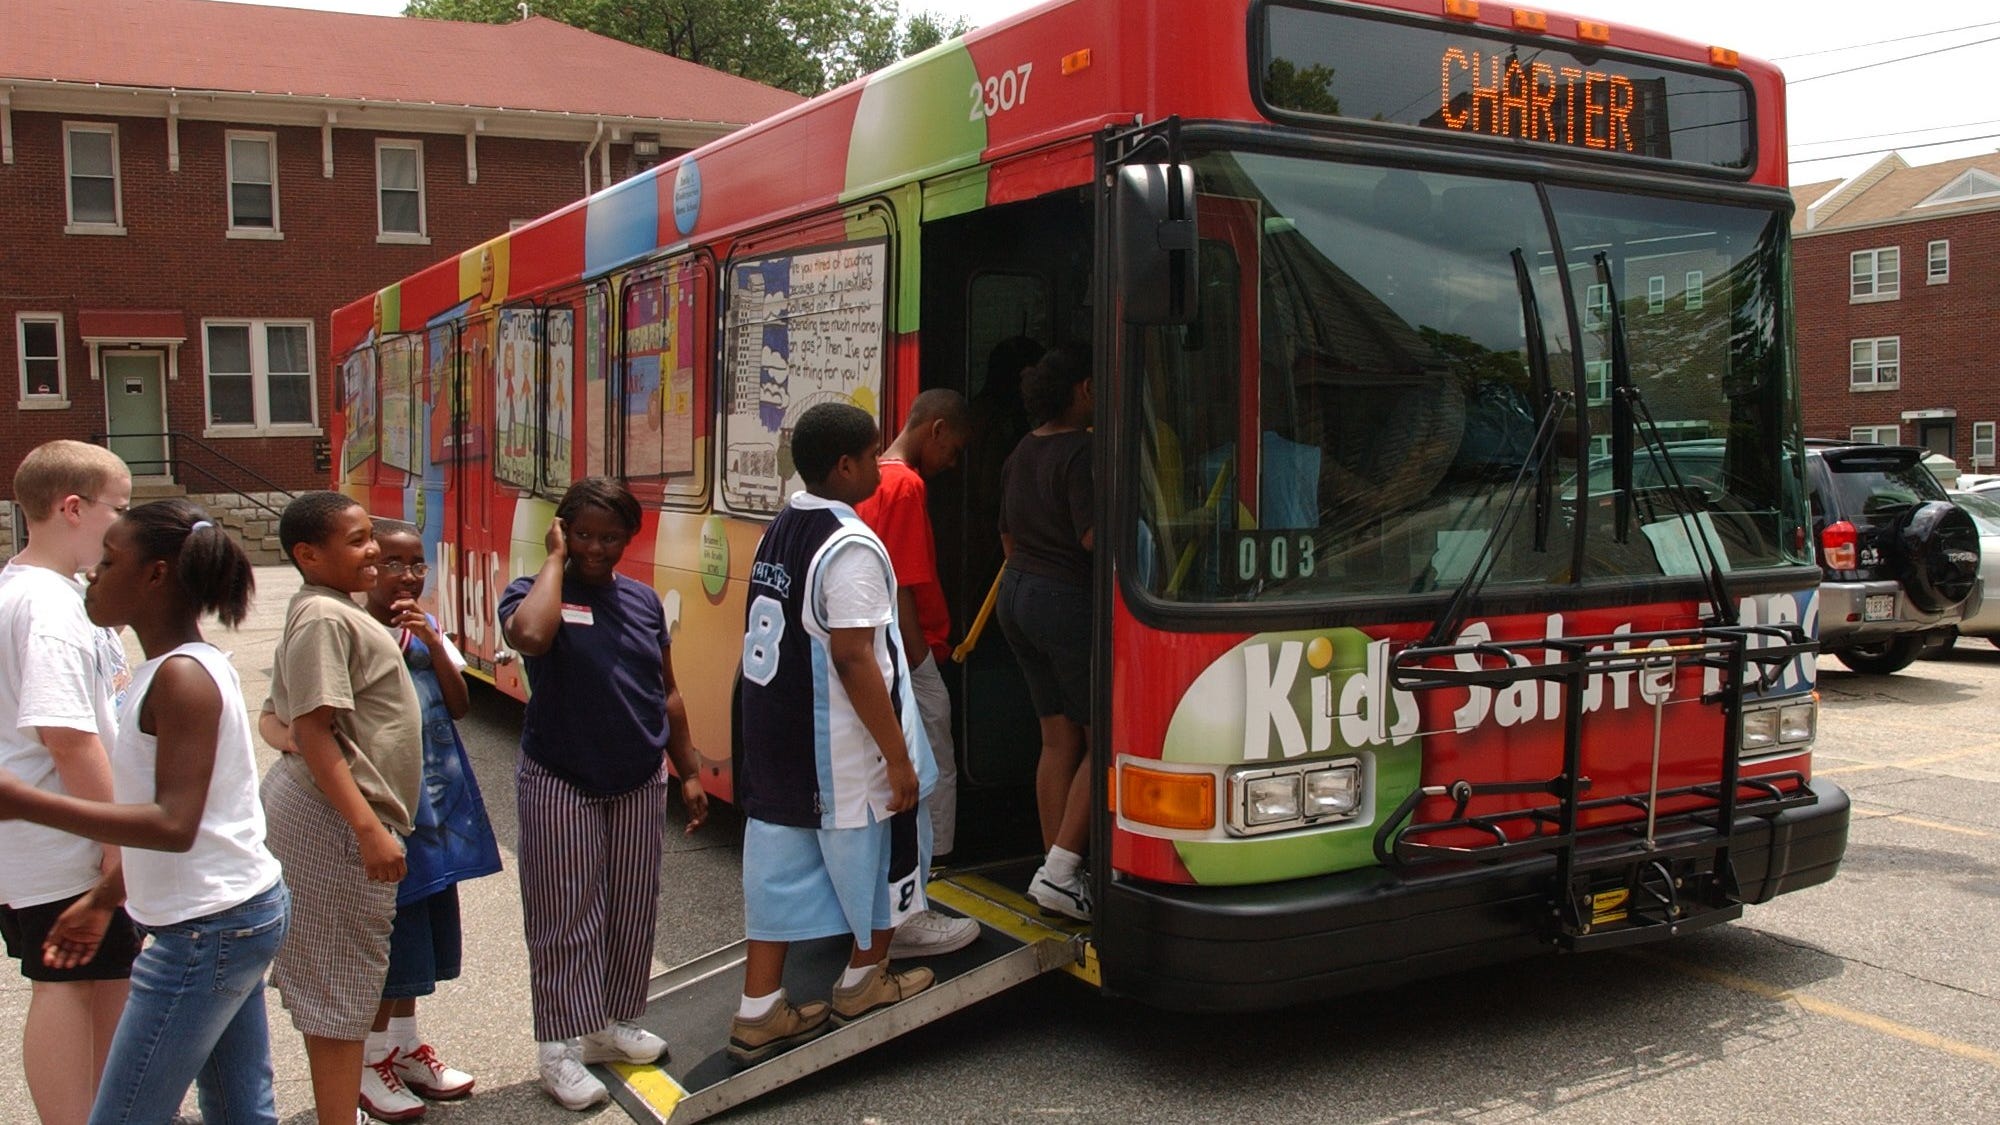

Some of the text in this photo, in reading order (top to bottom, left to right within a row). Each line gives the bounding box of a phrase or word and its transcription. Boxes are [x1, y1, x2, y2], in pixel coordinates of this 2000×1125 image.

[969, 62, 1033, 122] 2307
[1441, 47, 1635, 151] CHARTER
[815, 257, 831, 271] tired
[852, 321, 881, 341] money
[825, 336, 843, 355] Then
[863, 345, 878, 371] got
[803, 362, 823, 390] thing
[824, 359, 838, 380] for
[743, 594, 786, 687] 8
[1243, 636, 1420, 760] Kids
[1453, 613, 1672, 734] Salute
[898, 879, 916, 912] 8
